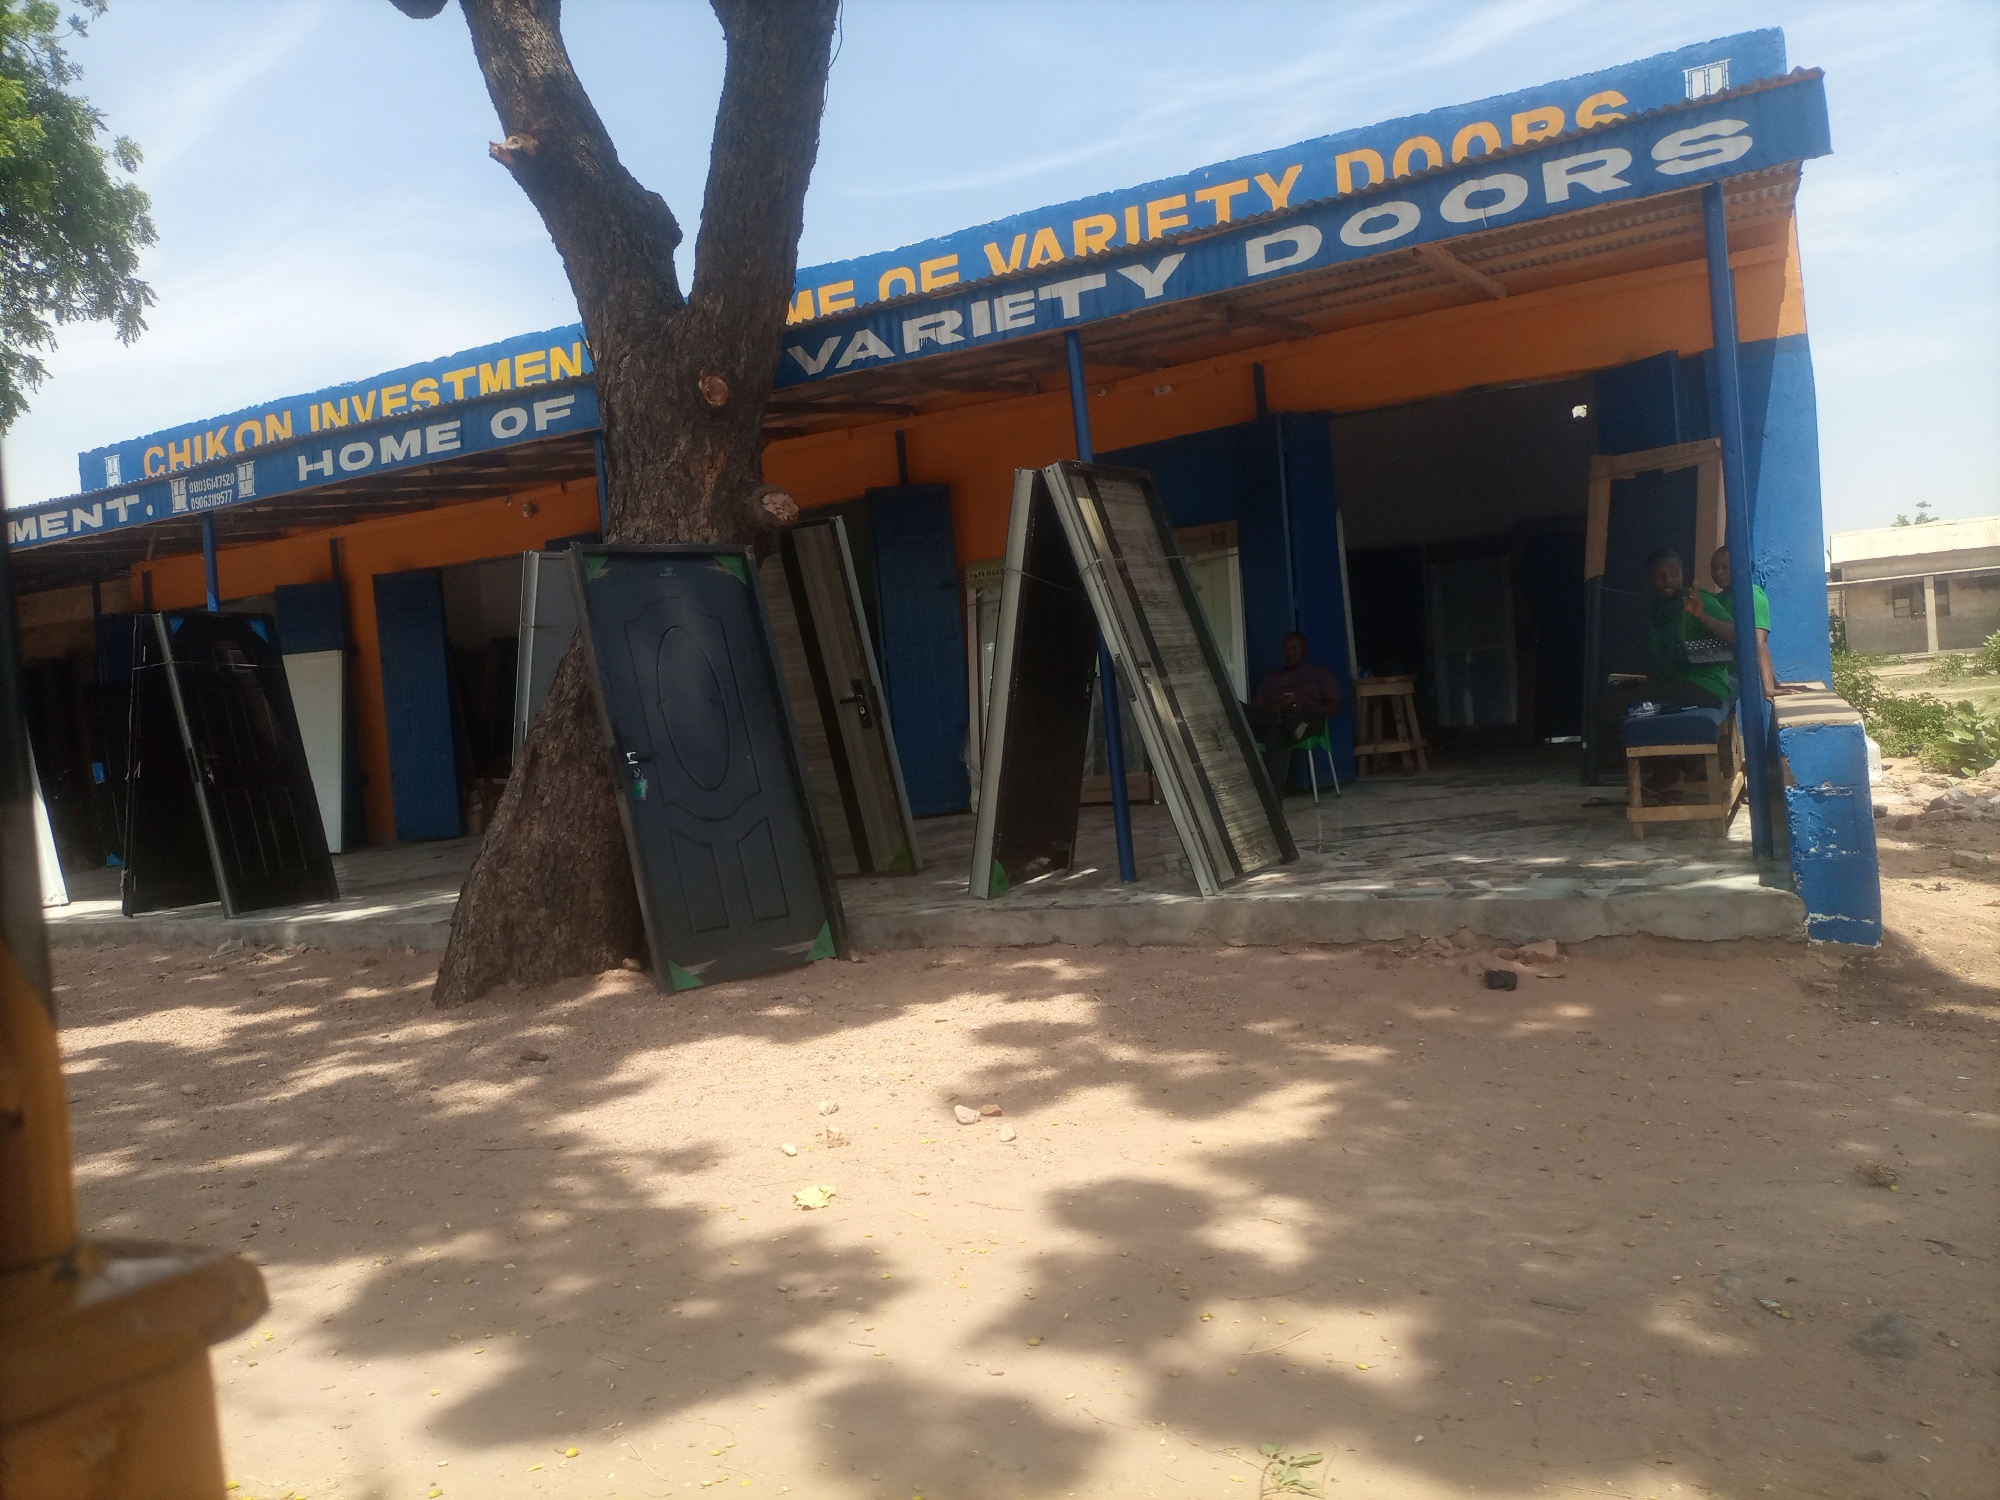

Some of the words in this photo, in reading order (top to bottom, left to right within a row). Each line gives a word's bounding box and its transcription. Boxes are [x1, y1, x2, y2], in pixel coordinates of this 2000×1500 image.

[8, 494, 153, 544] MENT.
[298, 419, 462, 481] HOME
[490, 395, 576, 439] OF
[787, 252, 1187, 376] VARIETY
[1246, 118, 1753, 277] DOORS
[143, 410, 293, 477] CHIKON
[309, 340, 590, 431] INVESTMEN
[878, 254, 960, 302] OF
[983, 164, 1303, 276] VARIETY
[1335, 90, 1628, 194] DOORS
